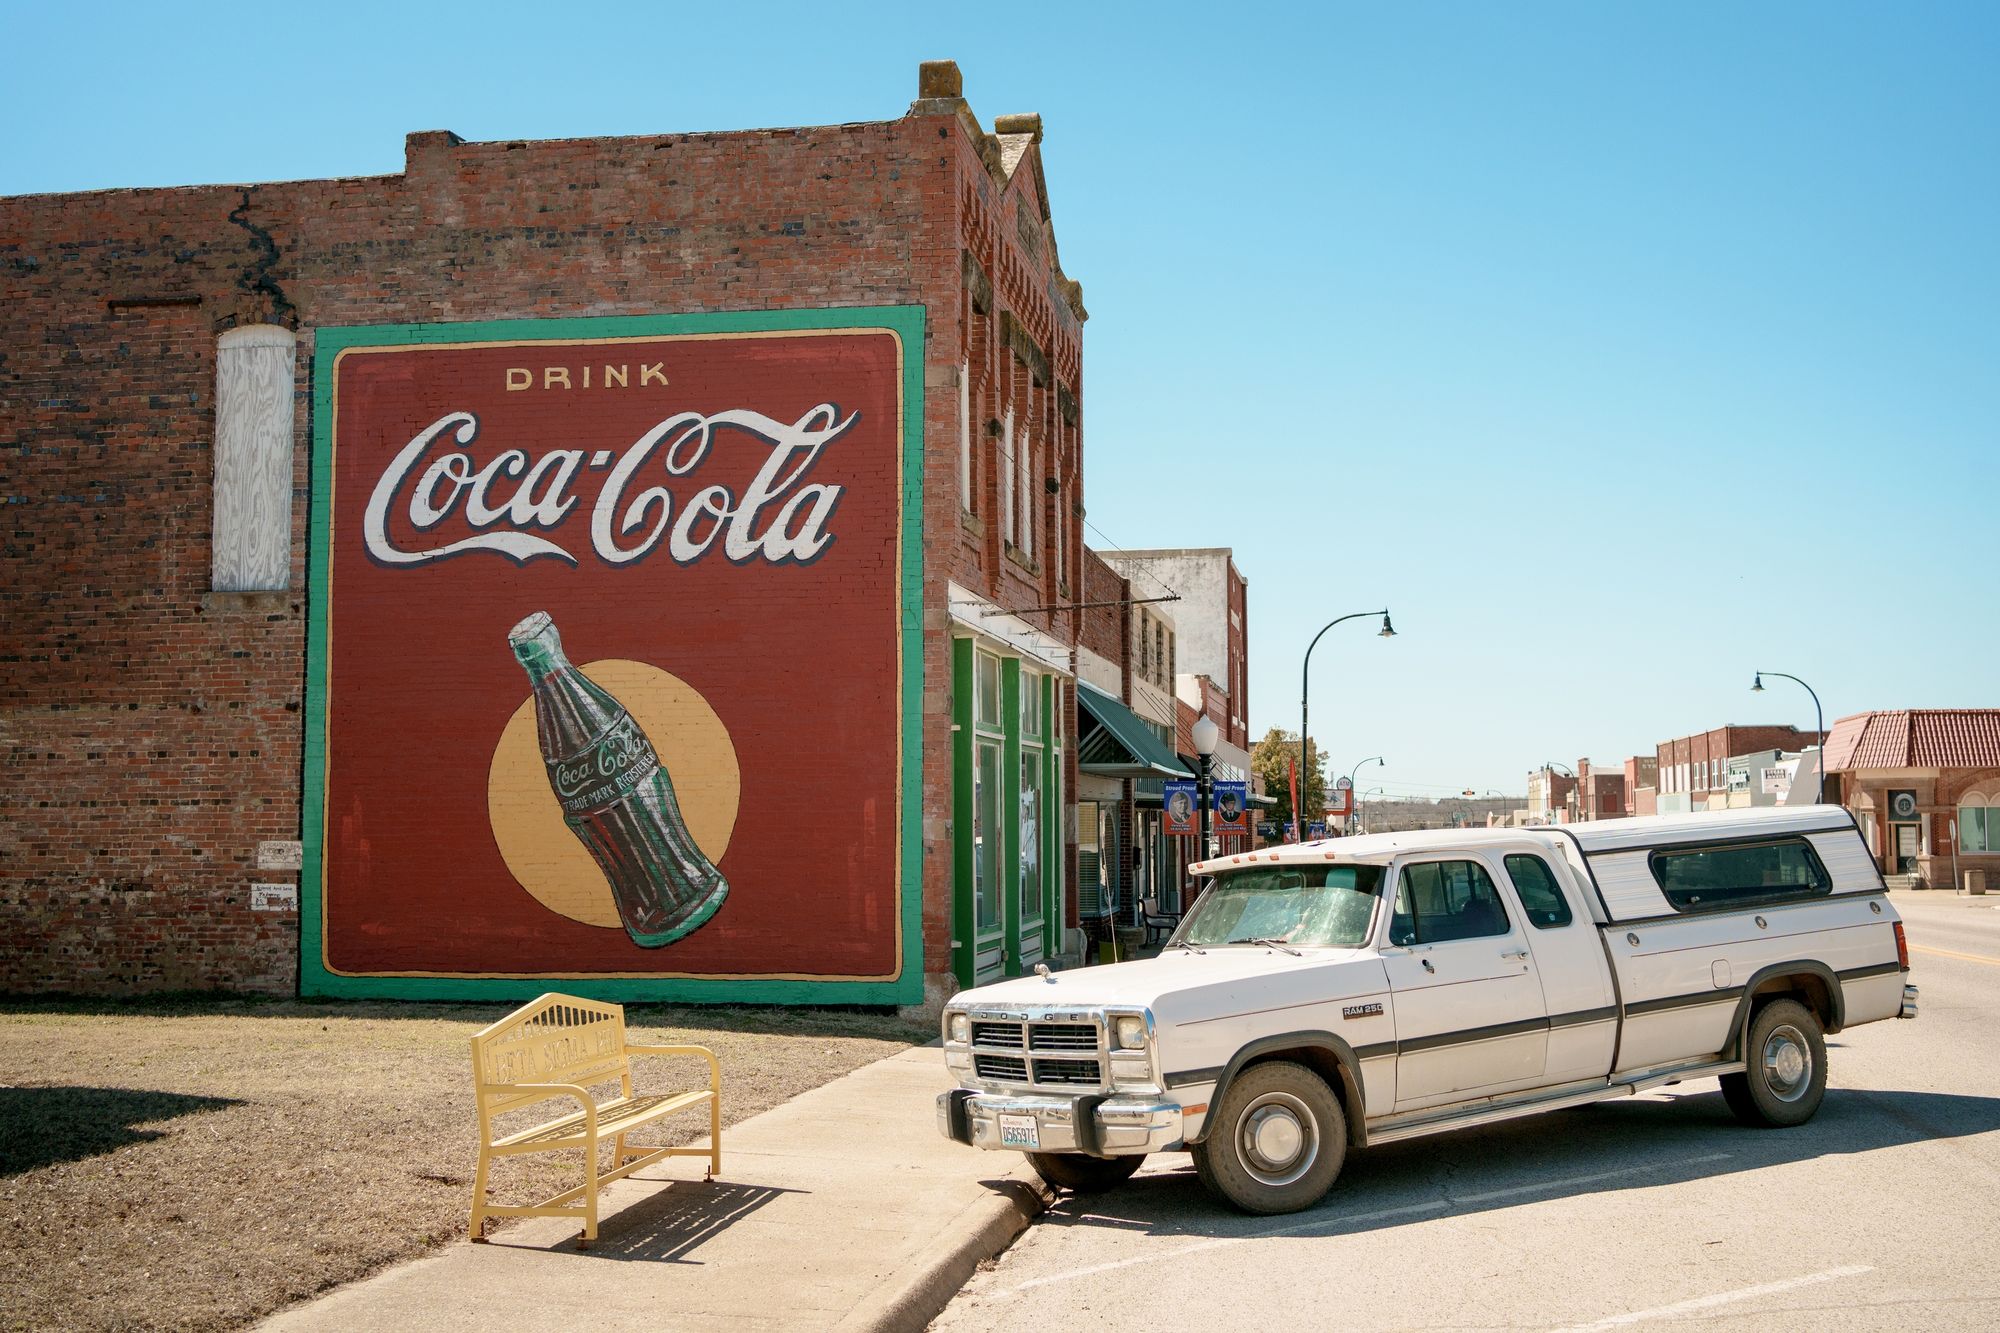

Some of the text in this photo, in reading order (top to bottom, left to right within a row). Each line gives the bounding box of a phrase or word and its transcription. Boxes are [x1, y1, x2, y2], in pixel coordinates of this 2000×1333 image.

[505, 361, 670, 392] DRINK
[363, 402, 861, 568] Coca-Cola
[556, 727, 652, 798] Coca Cola
[981, 1012, 1079, 1021] DODGE
[1344, 1004, 1384, 1016] RAM 250
[543, 1036, 590, 1073] SIGMA
